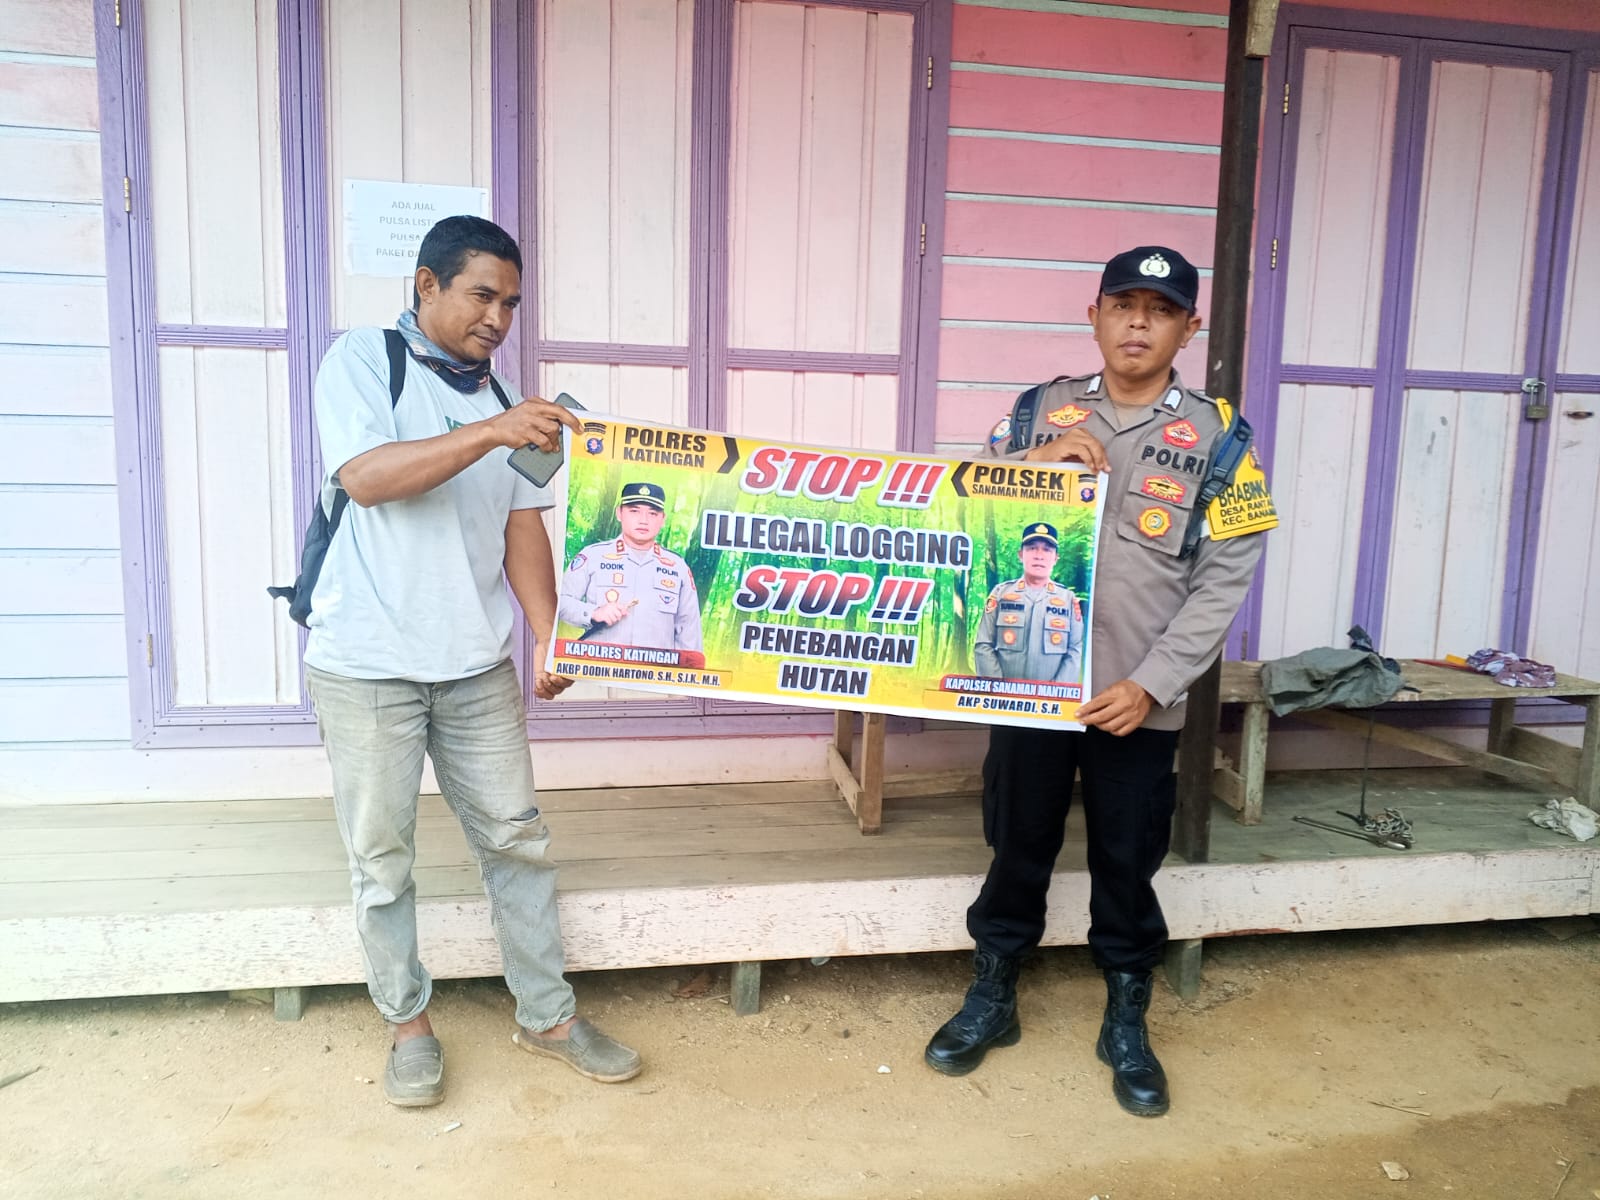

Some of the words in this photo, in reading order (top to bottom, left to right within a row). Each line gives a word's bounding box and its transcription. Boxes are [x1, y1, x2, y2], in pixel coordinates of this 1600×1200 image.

[391, 201, 412, 210] ADA
[412, 201, 437, 211] JUAL
[379, 216, 410, 226] PULSA
[412, 217, 437, 227] LIST
[390, 232, 421, 241] PULSA
[376, 247, 406, 257] PAKET
[624, 426, 708, 453] POLRES
[623, 447, 706, 468] KATINGAN
[1141, 445, 1205, 476] POLRI
[744, 447, 884, 498] STOP
[881, 462, 946, 504] !!!
[973, 465, 1066, 491] POLSEK
[972, 483, 1018, 498] SANAMAN
[1020, 489, 1065, 502] MANTIKEI
[1220, 505, 1246, 518] DESA
[1222, 515, 1246, 527] KEC.
[704, 512, 827, 555] ILLEGAL
[833, 524, 970, 567] LOGGING
[600, 562, 625, 571] DODIK
[736, 567, 871, 616] STOP
[871, 579, 932, 621] !!!
[1045, 605, 1070, 616] POLRI
[565, 642, 622, 660] KAPOLRES
[623, 648, 680, 665] KATINGAN
[742, 625, 916, 664] PENEBANGAN
[556, 662, 580, 675] AKBP
[582, 664, 611, 677] DODIK
[701, 675, 721, 687] M.H.
[780, 664, 869, 695] HUTAN
[945, 677, 992, 691] KAPOLSEK
[992, 680, 1037, 695] SANAMAN
[957, 695, 981, 708] AKP
[1040, 702, 1062, 715] S.H.
